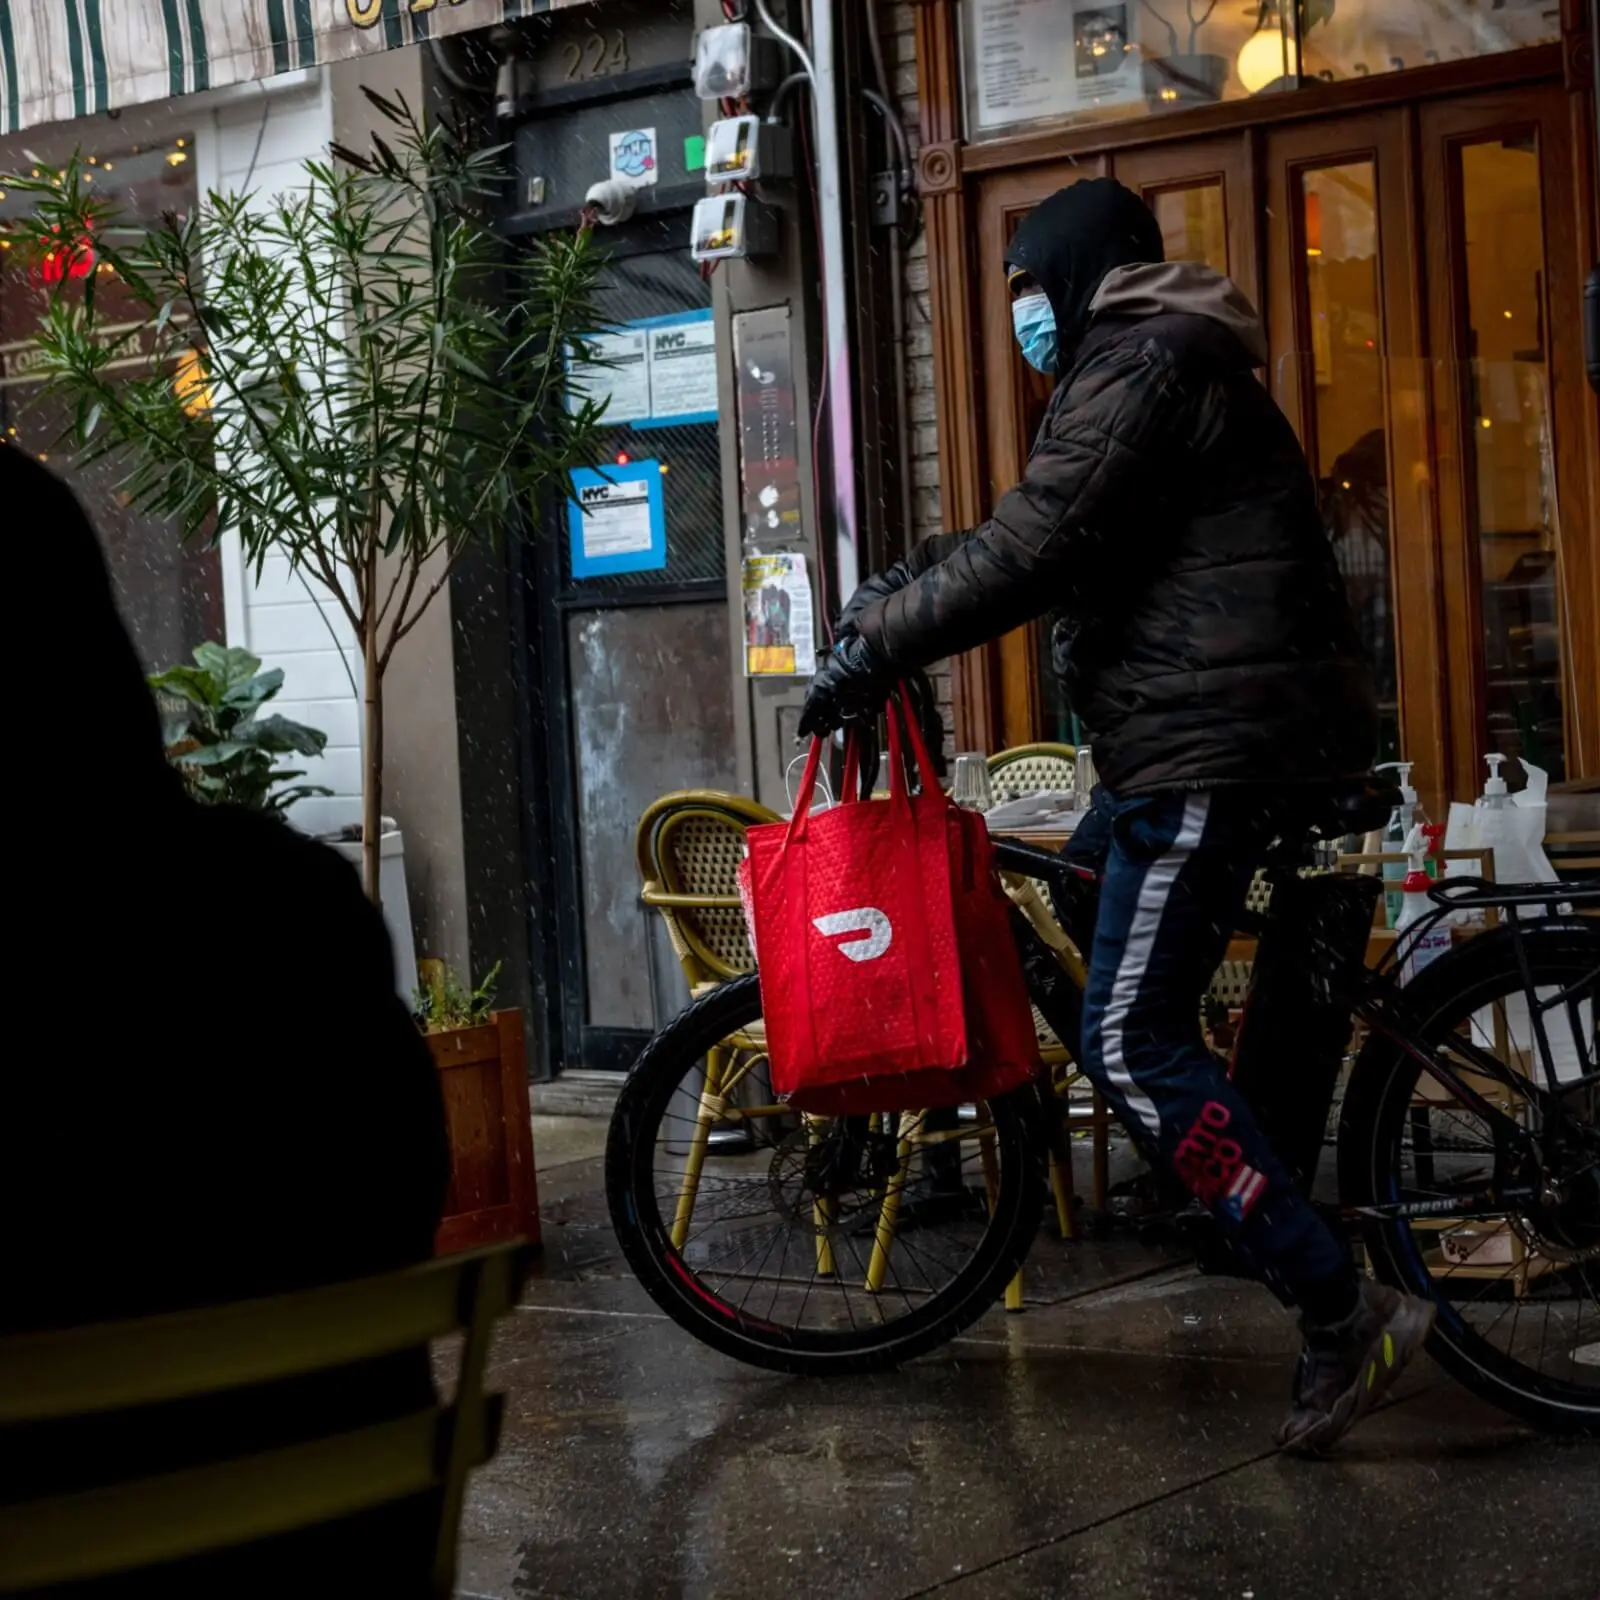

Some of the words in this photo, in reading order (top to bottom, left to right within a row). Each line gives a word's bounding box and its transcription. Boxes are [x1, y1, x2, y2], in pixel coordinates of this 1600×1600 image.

[562, 31, 630, 81] 224
[655, 332, 686, 350] NYC
[581, 485, 609, 502] NYC
